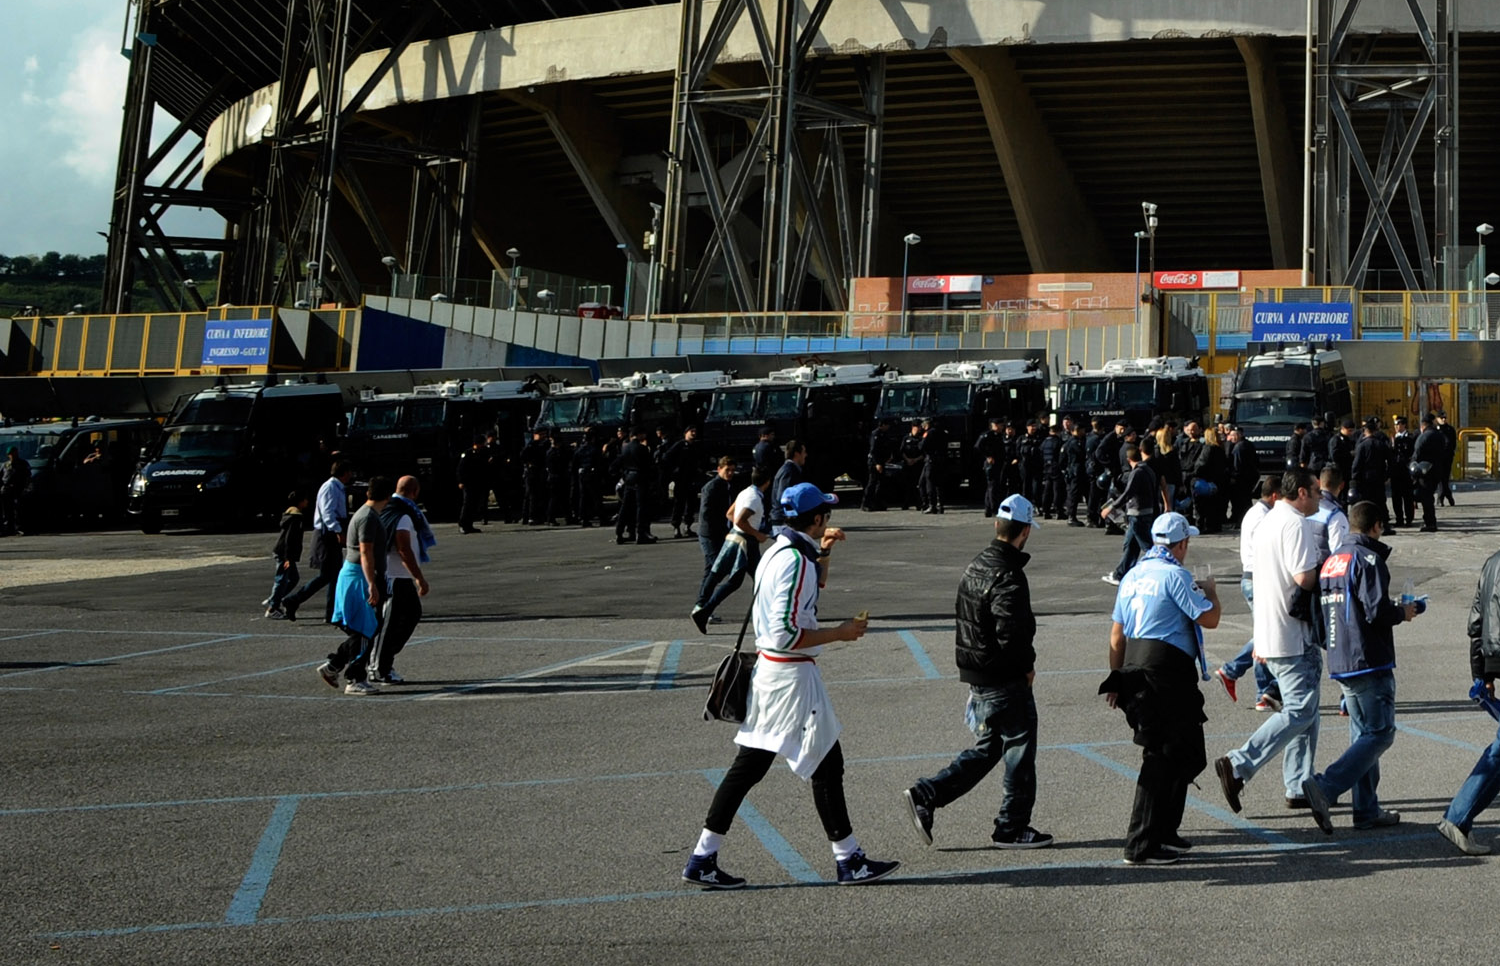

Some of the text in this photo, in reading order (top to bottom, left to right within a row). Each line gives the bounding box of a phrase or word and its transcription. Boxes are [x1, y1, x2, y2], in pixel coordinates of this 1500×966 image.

[1255, 312, 1349, 324] CURVA A INFERIORE
[233, 327, 269, 339] INFERIORE
[151, 469, 206, 477] CARABINIERI
